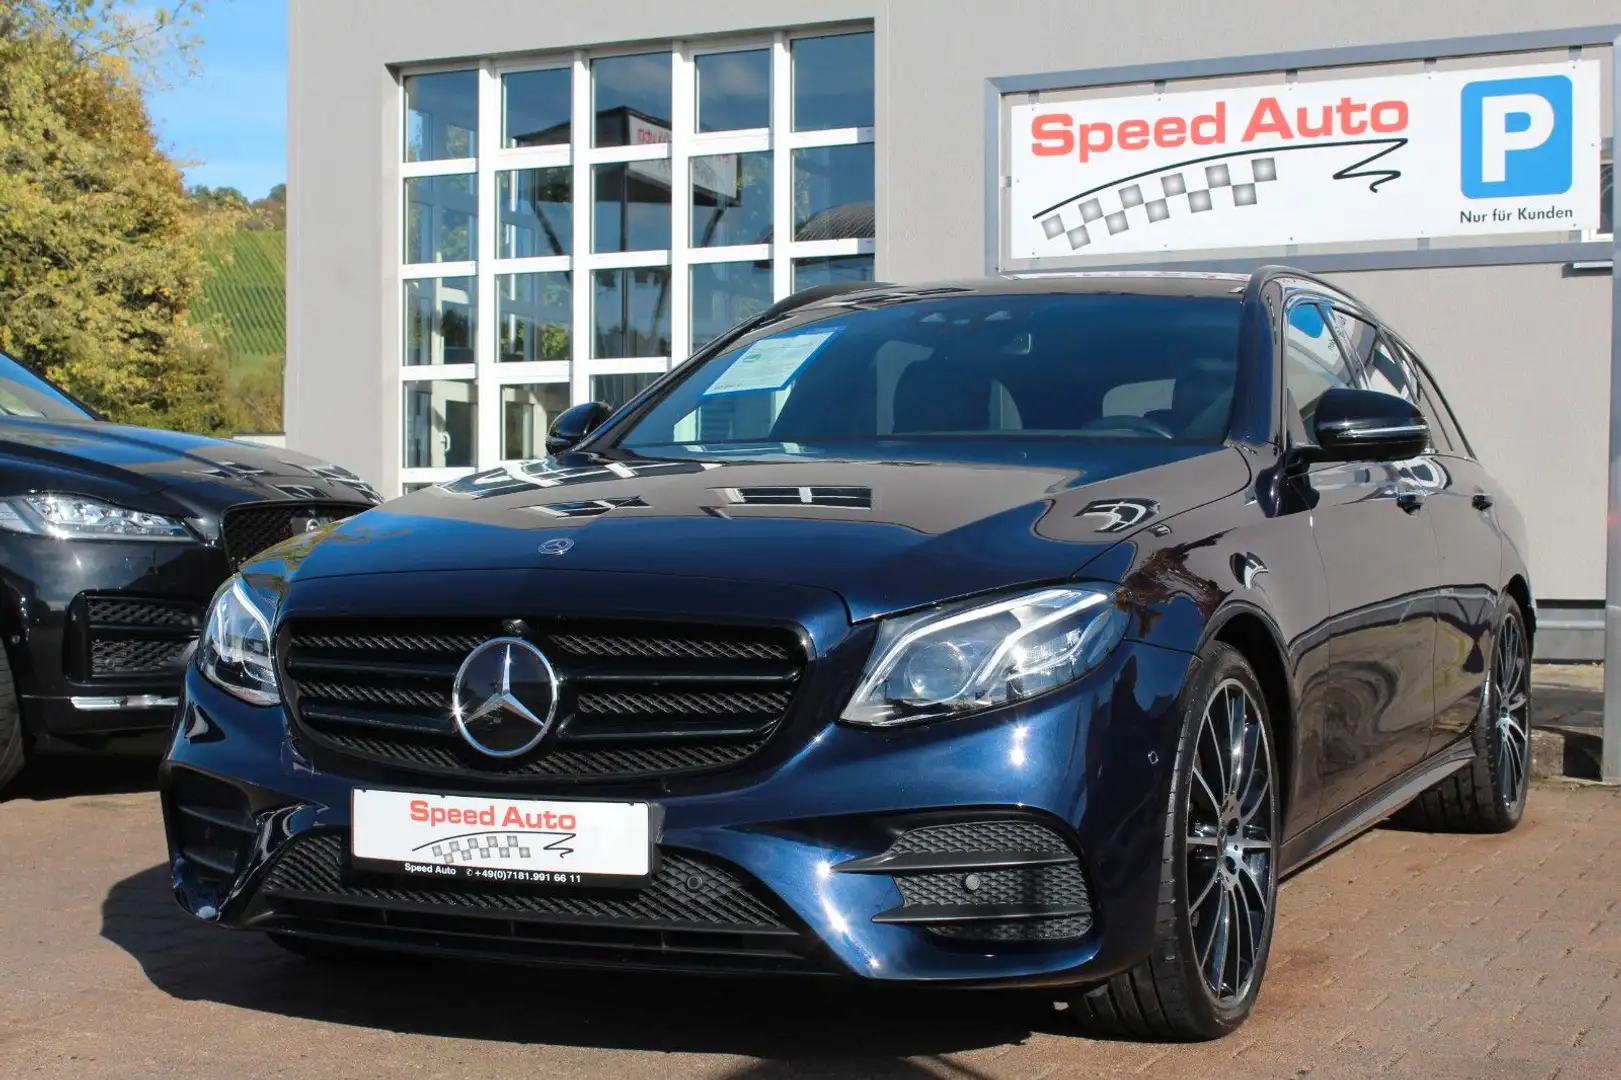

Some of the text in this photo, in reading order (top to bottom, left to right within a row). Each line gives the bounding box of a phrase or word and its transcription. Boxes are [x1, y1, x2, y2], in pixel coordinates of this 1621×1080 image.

[1031, 96, 1410, 163] Speed Auto
[1482, 93, 1555, 183] P
[1460, 205, 1573, 223] Nur für Kunden
[410, 799, 577, 831] Speed Auto
[404, 862, 581, 883] Speed Auto +49(0)7181.991 66 11
